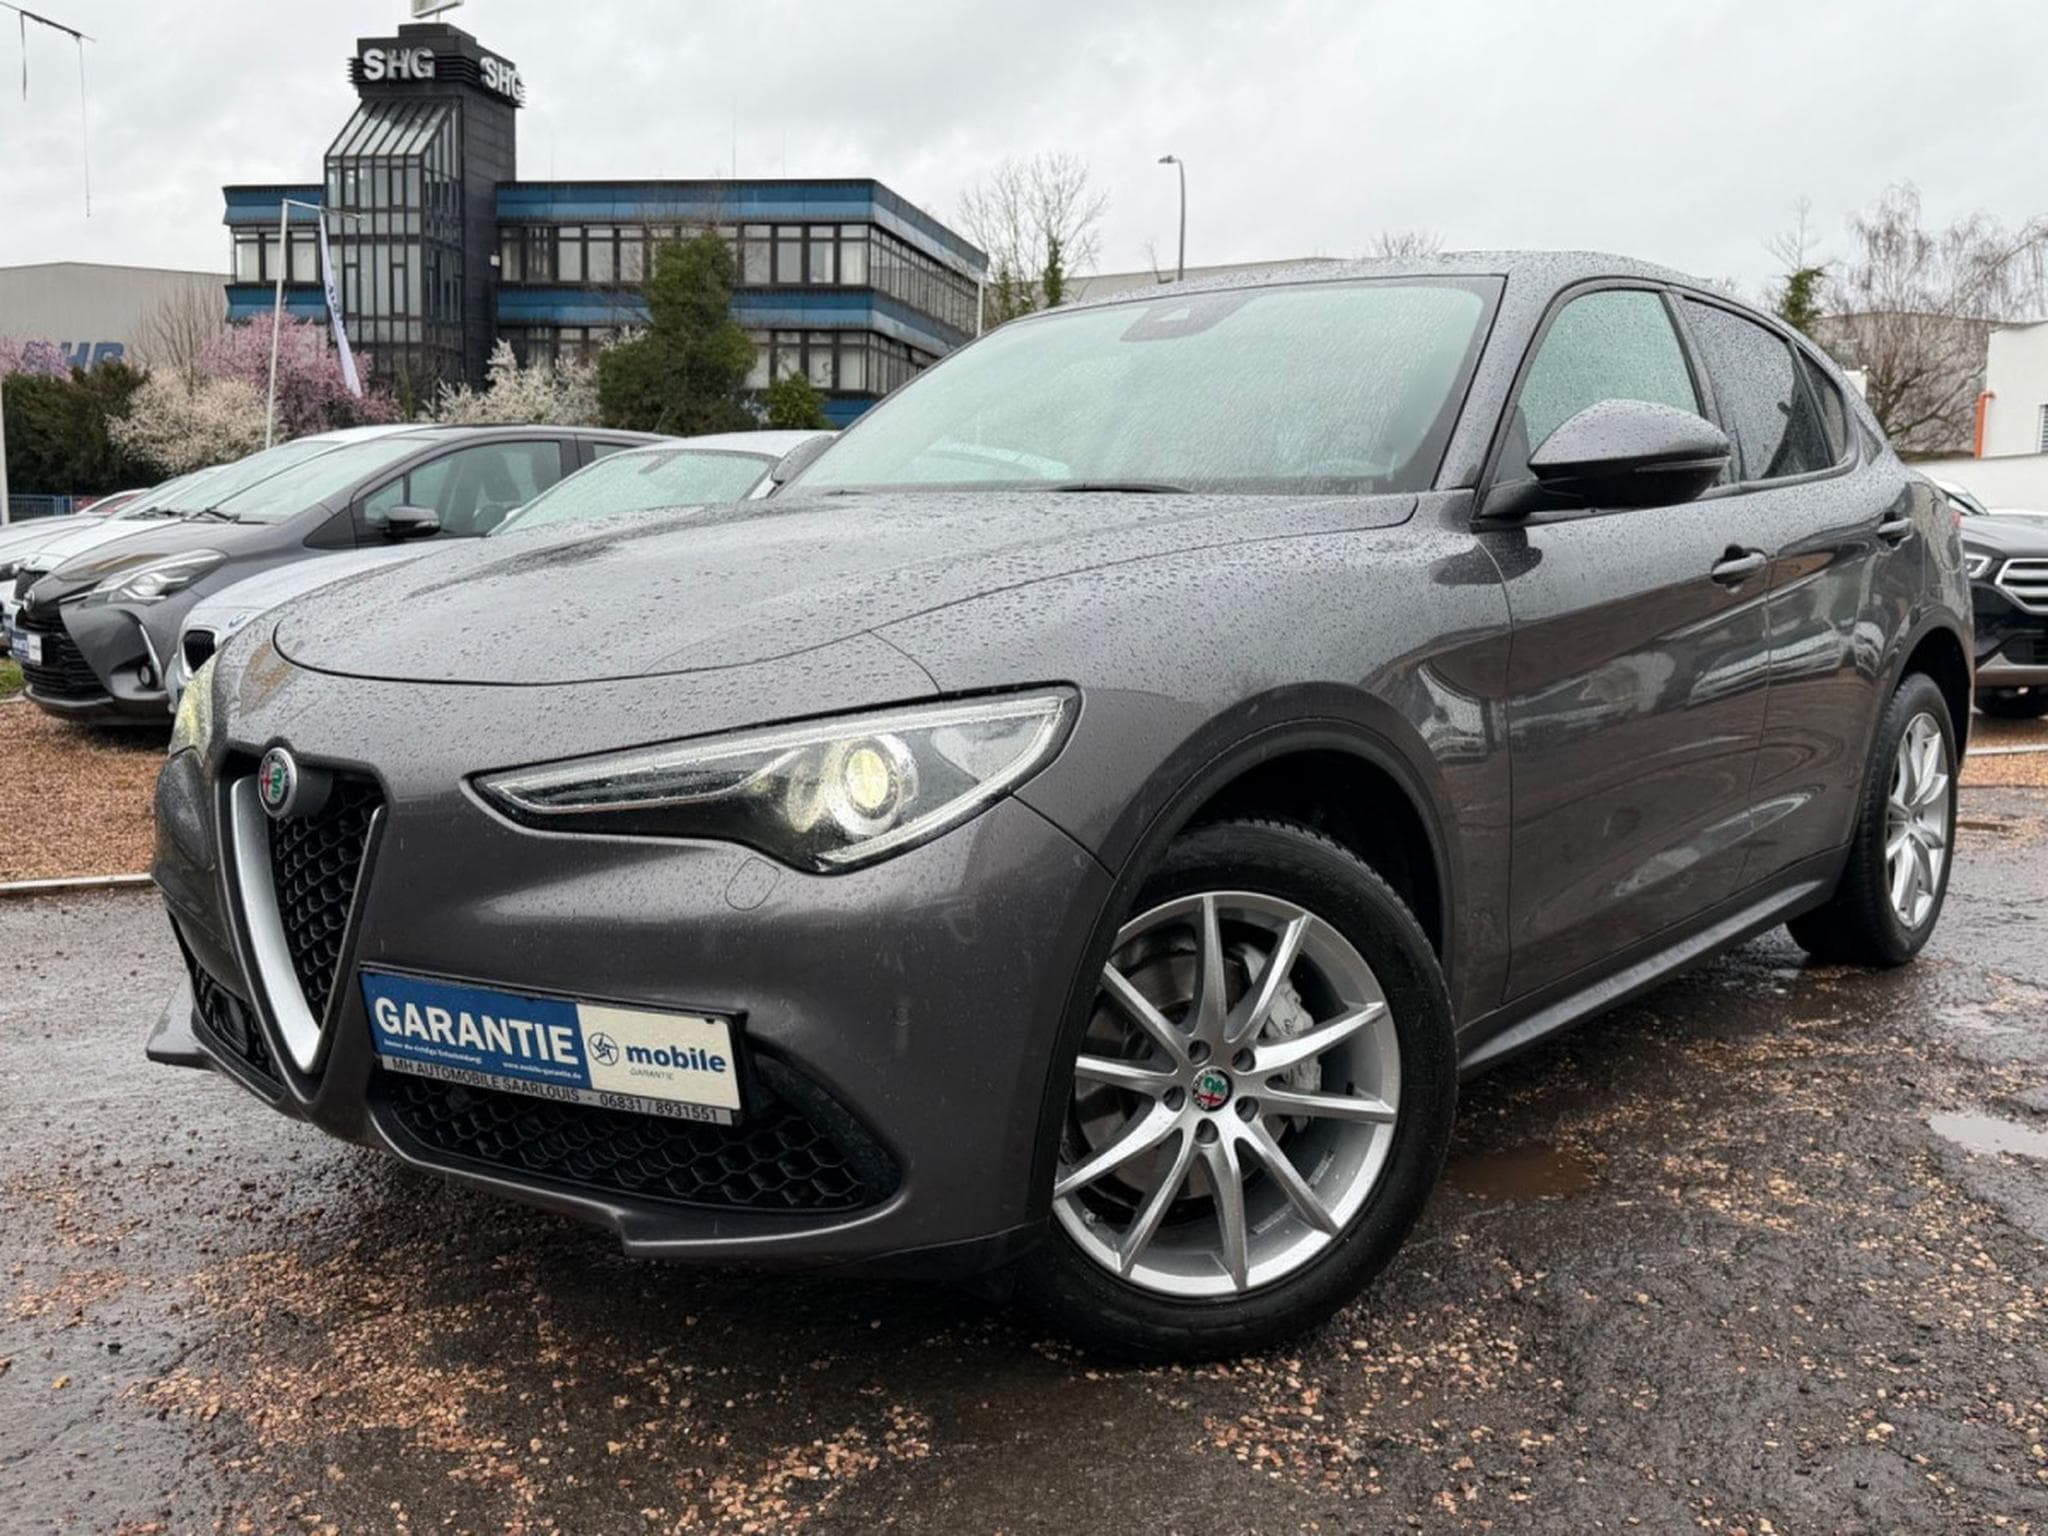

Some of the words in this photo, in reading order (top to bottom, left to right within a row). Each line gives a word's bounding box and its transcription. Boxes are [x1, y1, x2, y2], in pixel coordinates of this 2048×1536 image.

[362, 47, 435, 81] SHG
[480, 56, 524, 101] SHG
[374, 997, 579, 1065] GARANTIE
[626, 1044, 726, 1073] mobile
[629, 1067, 675, 1081] GARANTIE
[392, 1057, 414, 1073] MH
[417, 1063, 500, 1089] AUTOMOBILE
[503, 1078, 580, 1102] SAARLOUIS
[600, 1090, 643, 1112] 06831
[655, 1101, 719, 1122] 8931551
